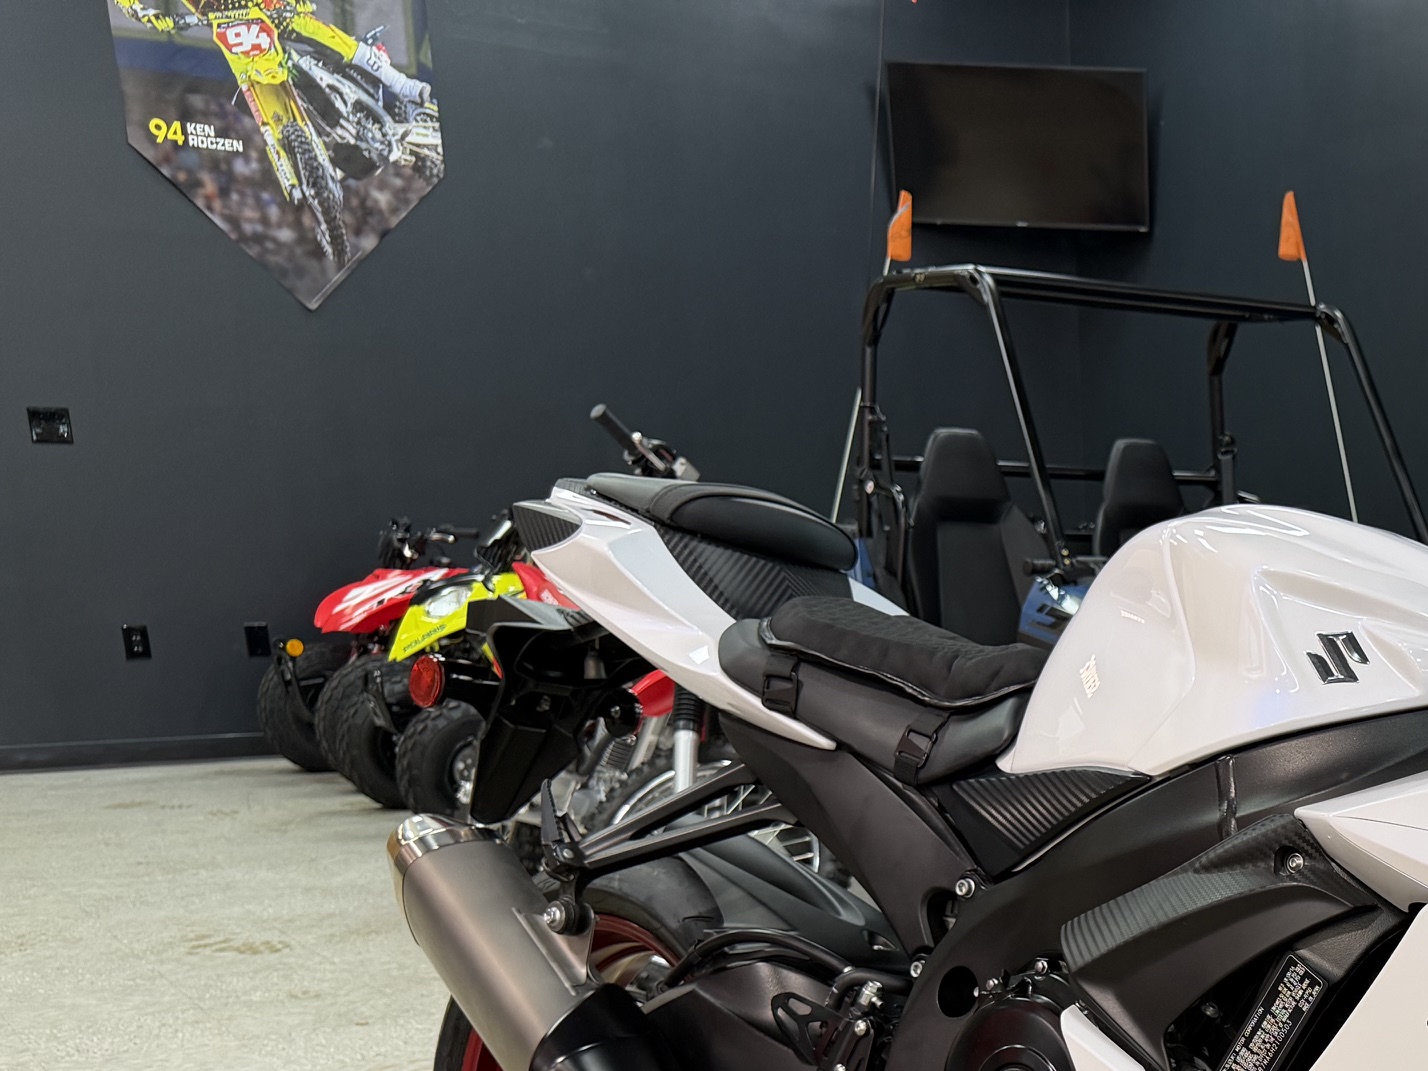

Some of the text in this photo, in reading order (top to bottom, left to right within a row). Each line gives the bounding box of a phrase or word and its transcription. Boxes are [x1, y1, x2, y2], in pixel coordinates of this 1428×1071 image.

[225, 24, 271, 53] 94
[148, 117, 185, 146] 94
[186, 121, 215, 137] KEN
